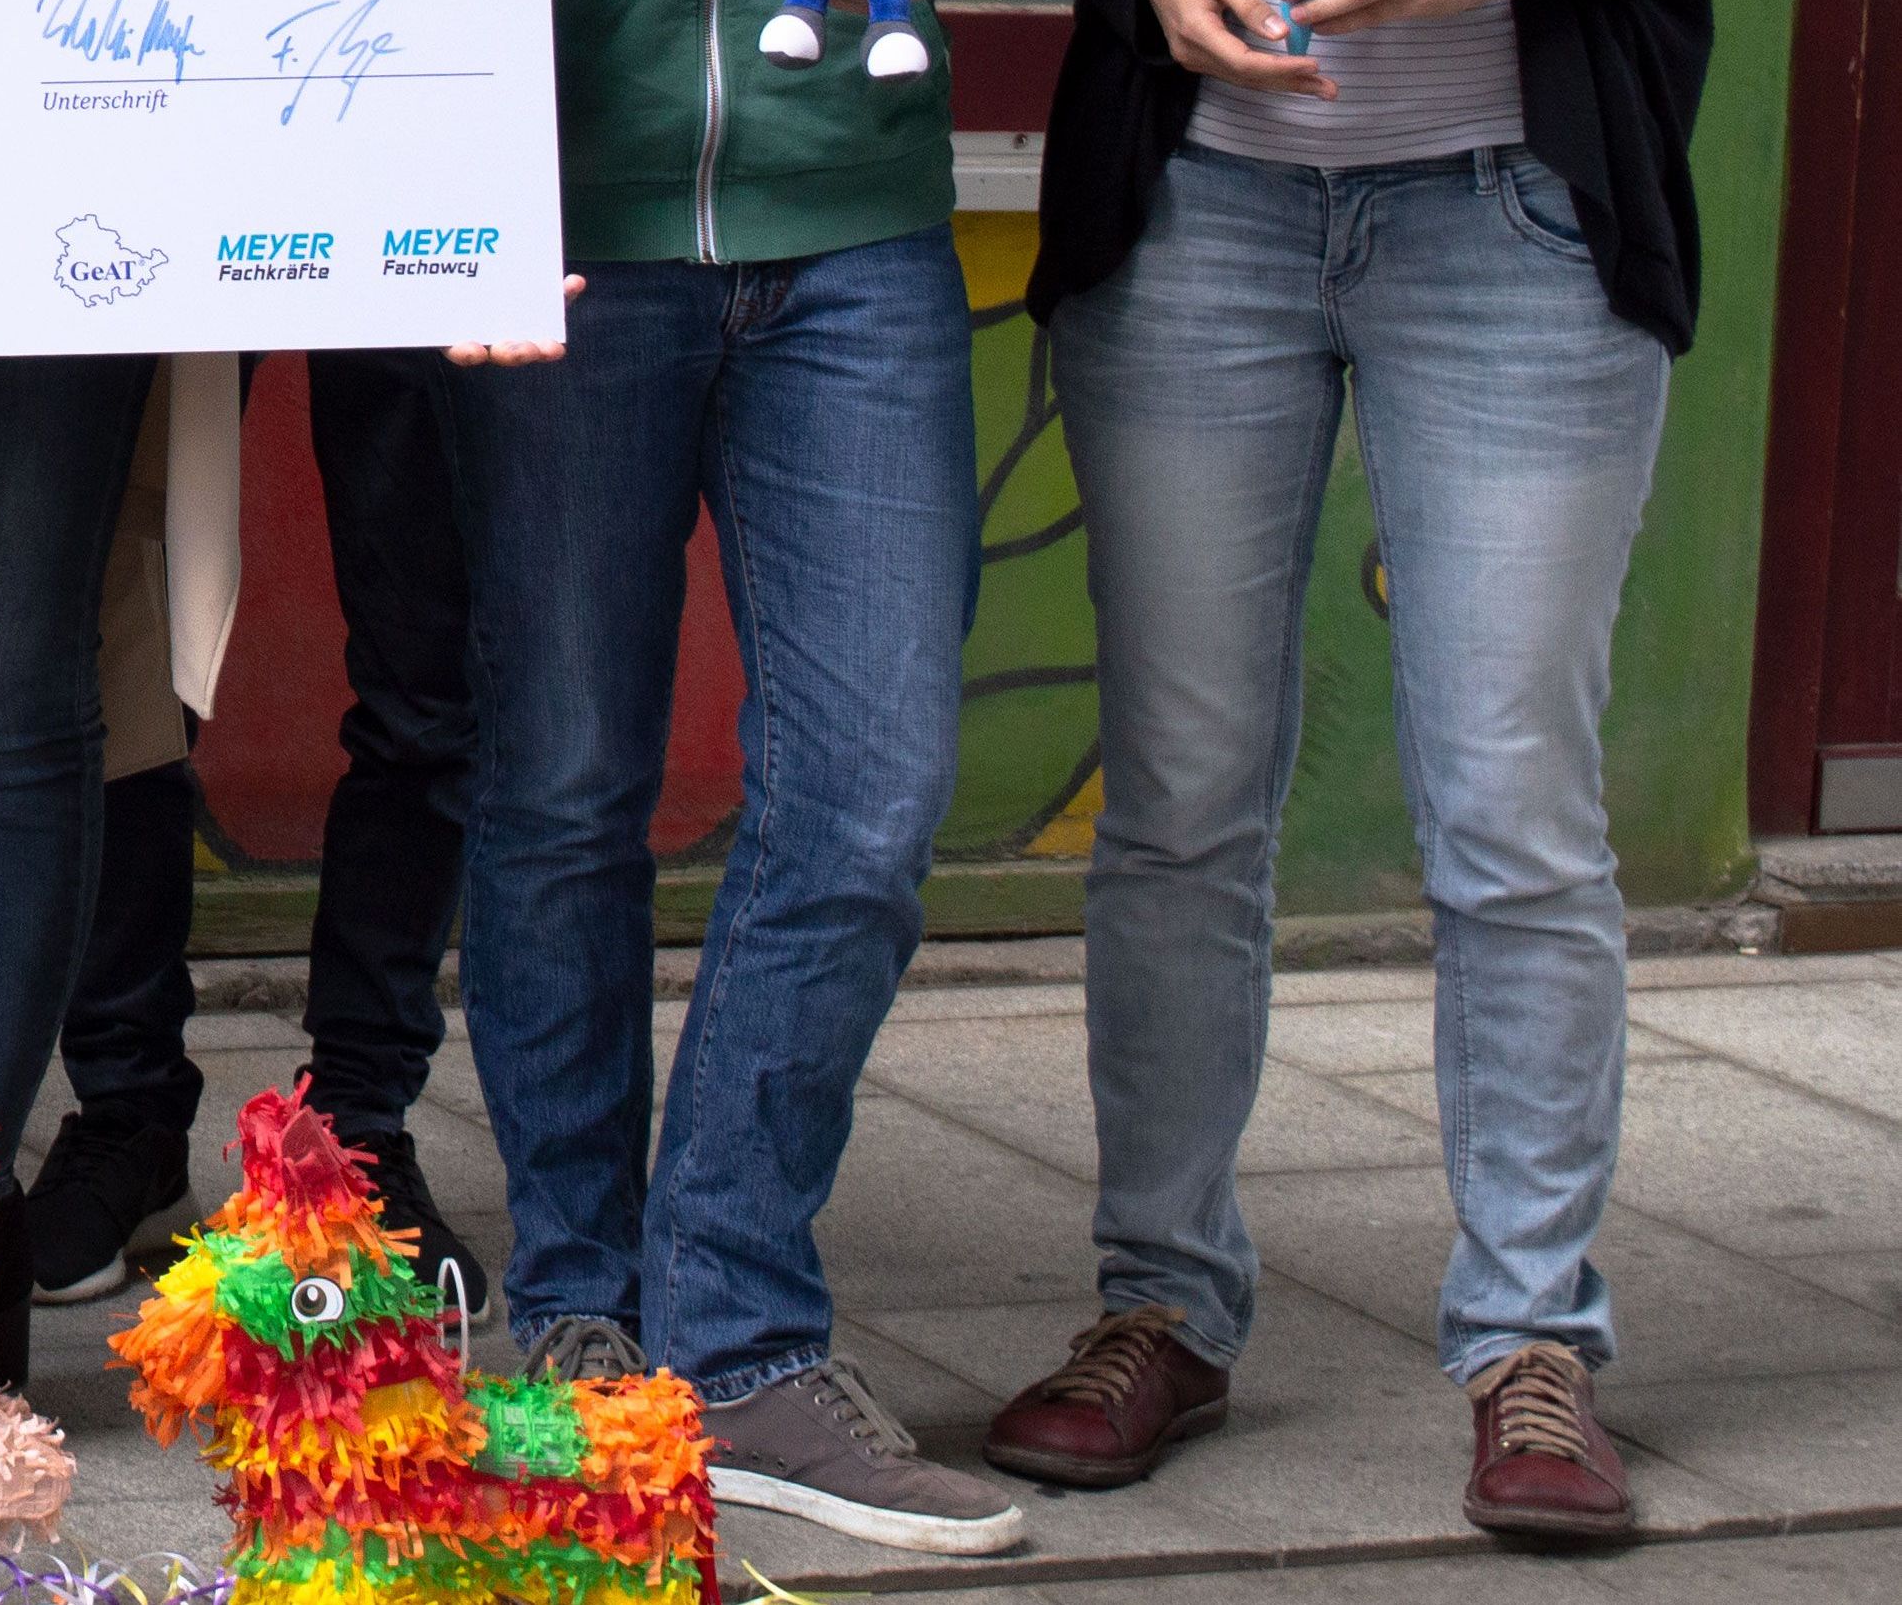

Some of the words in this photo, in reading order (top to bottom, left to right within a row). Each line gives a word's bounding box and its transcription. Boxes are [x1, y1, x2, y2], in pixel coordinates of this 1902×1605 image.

[42, 89, 169, 113] Unterschrift
[216, 232, 334, 262] MEYER
[382, 227, 500, 256] MEYER
[218, 263, 330, 282] Fachkräfte
[382, 259, 479, 278] Fachowcy
